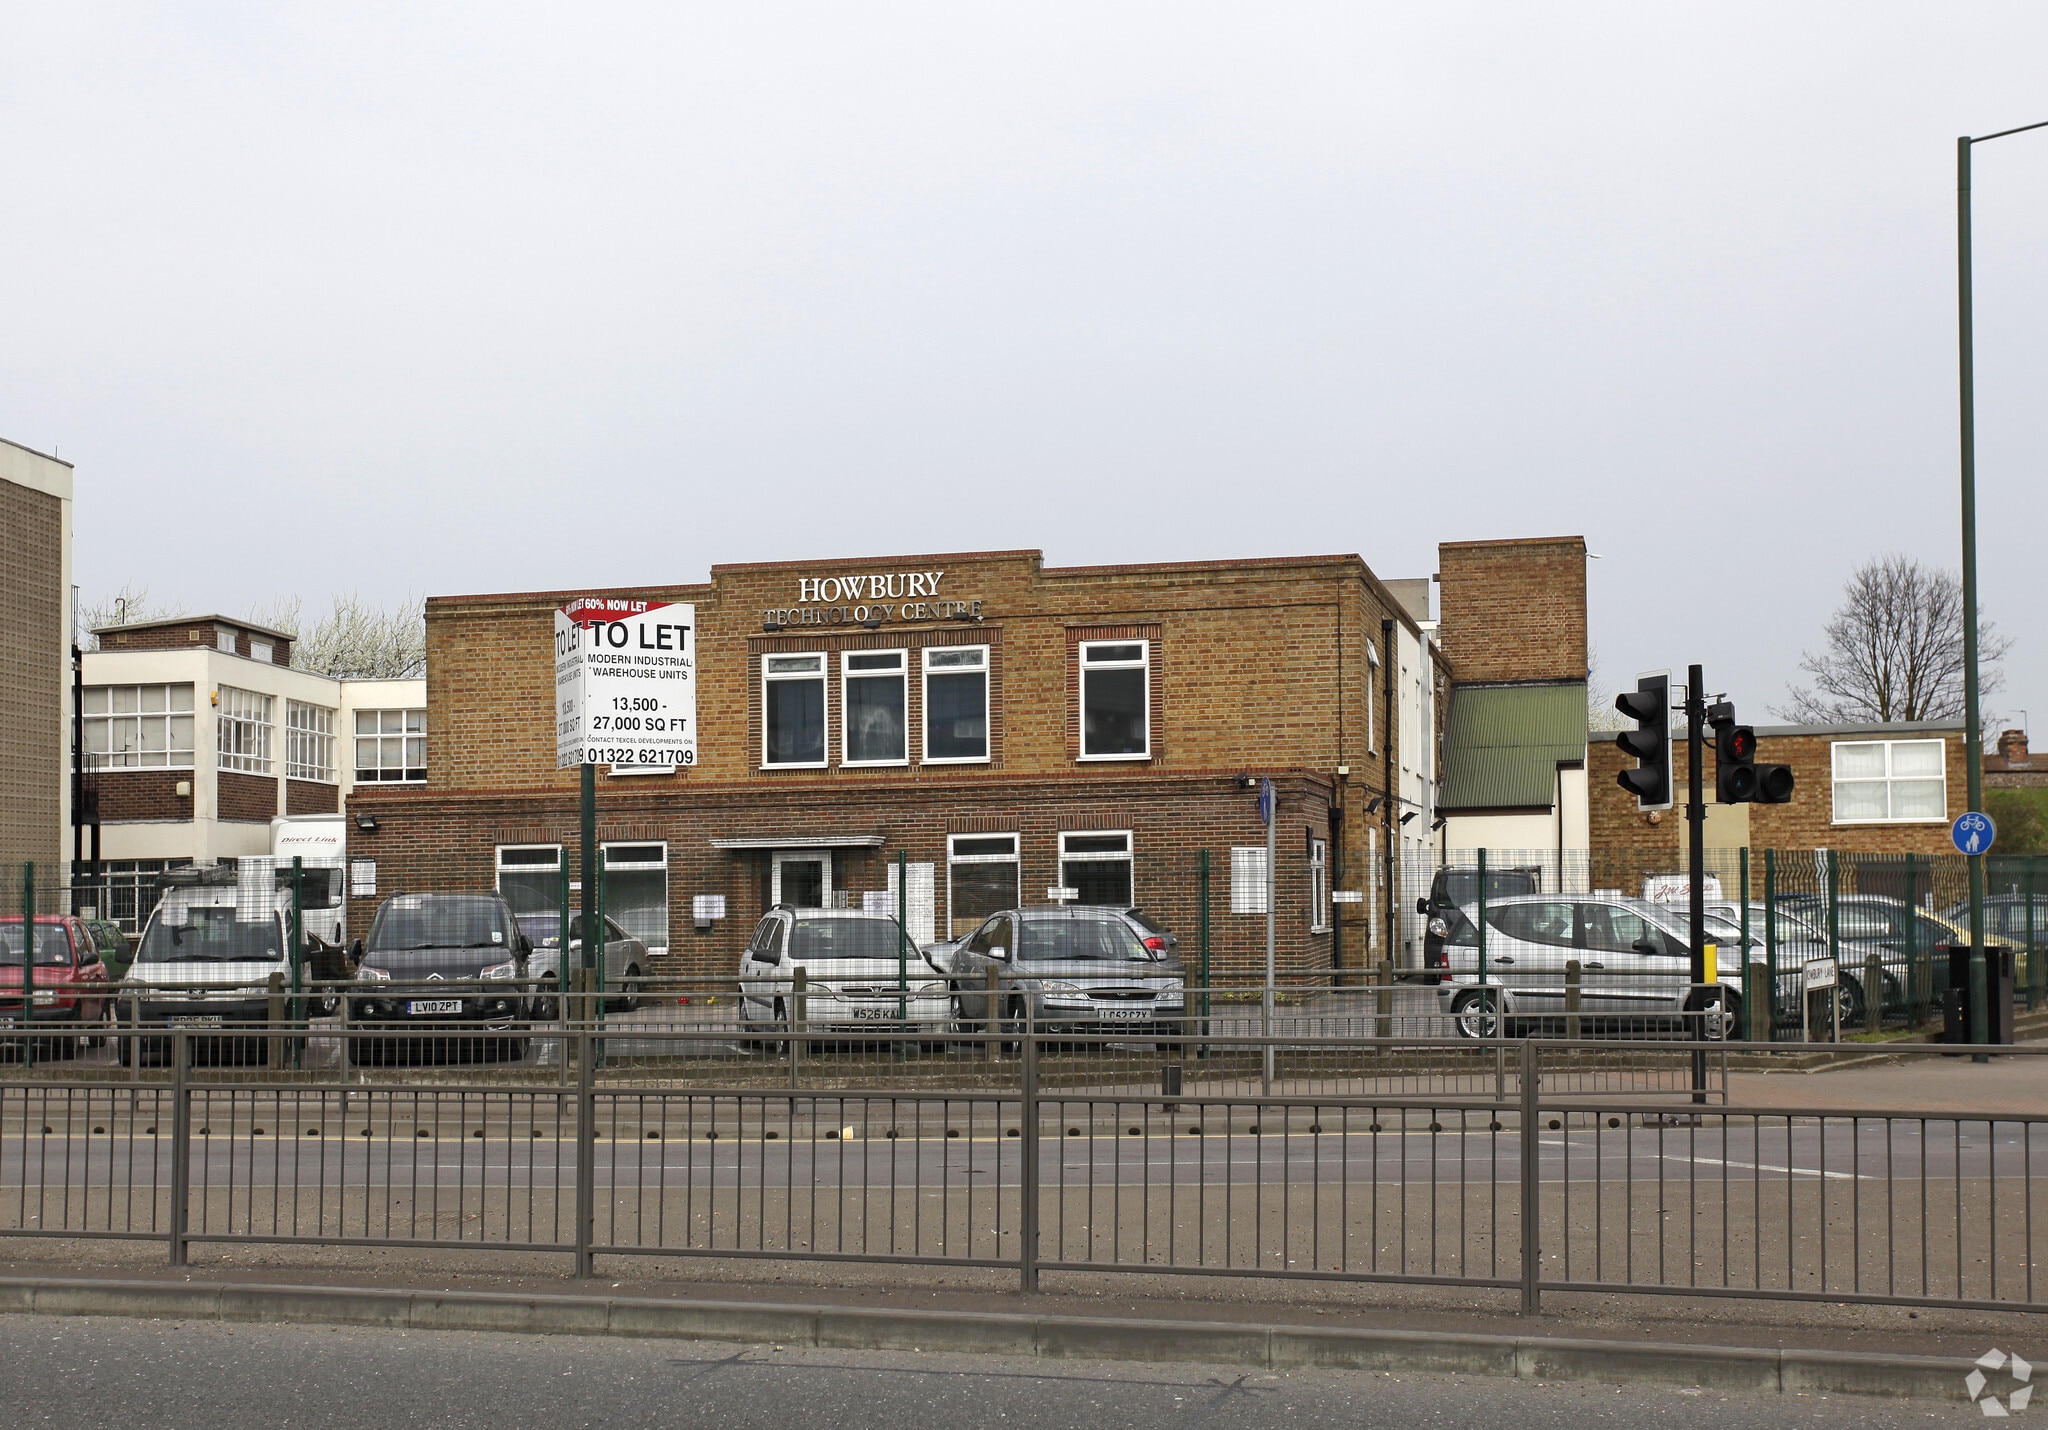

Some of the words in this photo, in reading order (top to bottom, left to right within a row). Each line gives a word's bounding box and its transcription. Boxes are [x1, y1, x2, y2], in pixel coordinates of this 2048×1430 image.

[798, 572, 944, 602] HOWBURY
[584, 598, 605, 610] 60%
[607, 599, 628, 611] NOW
[630, 601, 648, 613] LET
[763, 604, 896, 625] TECHNOLOGY
[901, 600, 982, 620] CENTRE
[556, 630, 566, 658] TO
[567, 621, 583, 653] LET
[588, 620, 629, 648] TO
[639, 623, 691, 651] LET
[587, 653, 631, 665] MODERN
[634, 655, 692, 668] INDUSTRIAL
[593, 667, 656, 679] WAREHOUSE
[659, 670, 688, 681] UNITS
[612, 697, 658, 712] 13,500
[593, 716, 641, 732] 27,000
[645, 718, 666, 732] SQ
[670, 719, 687, 732] FT
[588, 748, 634, 763] 01322
[638, 748, 693, 764] 621709
[415, 1002, 437, 1012] LV10
[440, 1001, 458, 1011] ZPT
[853, 1009, 880, 1020] W526
